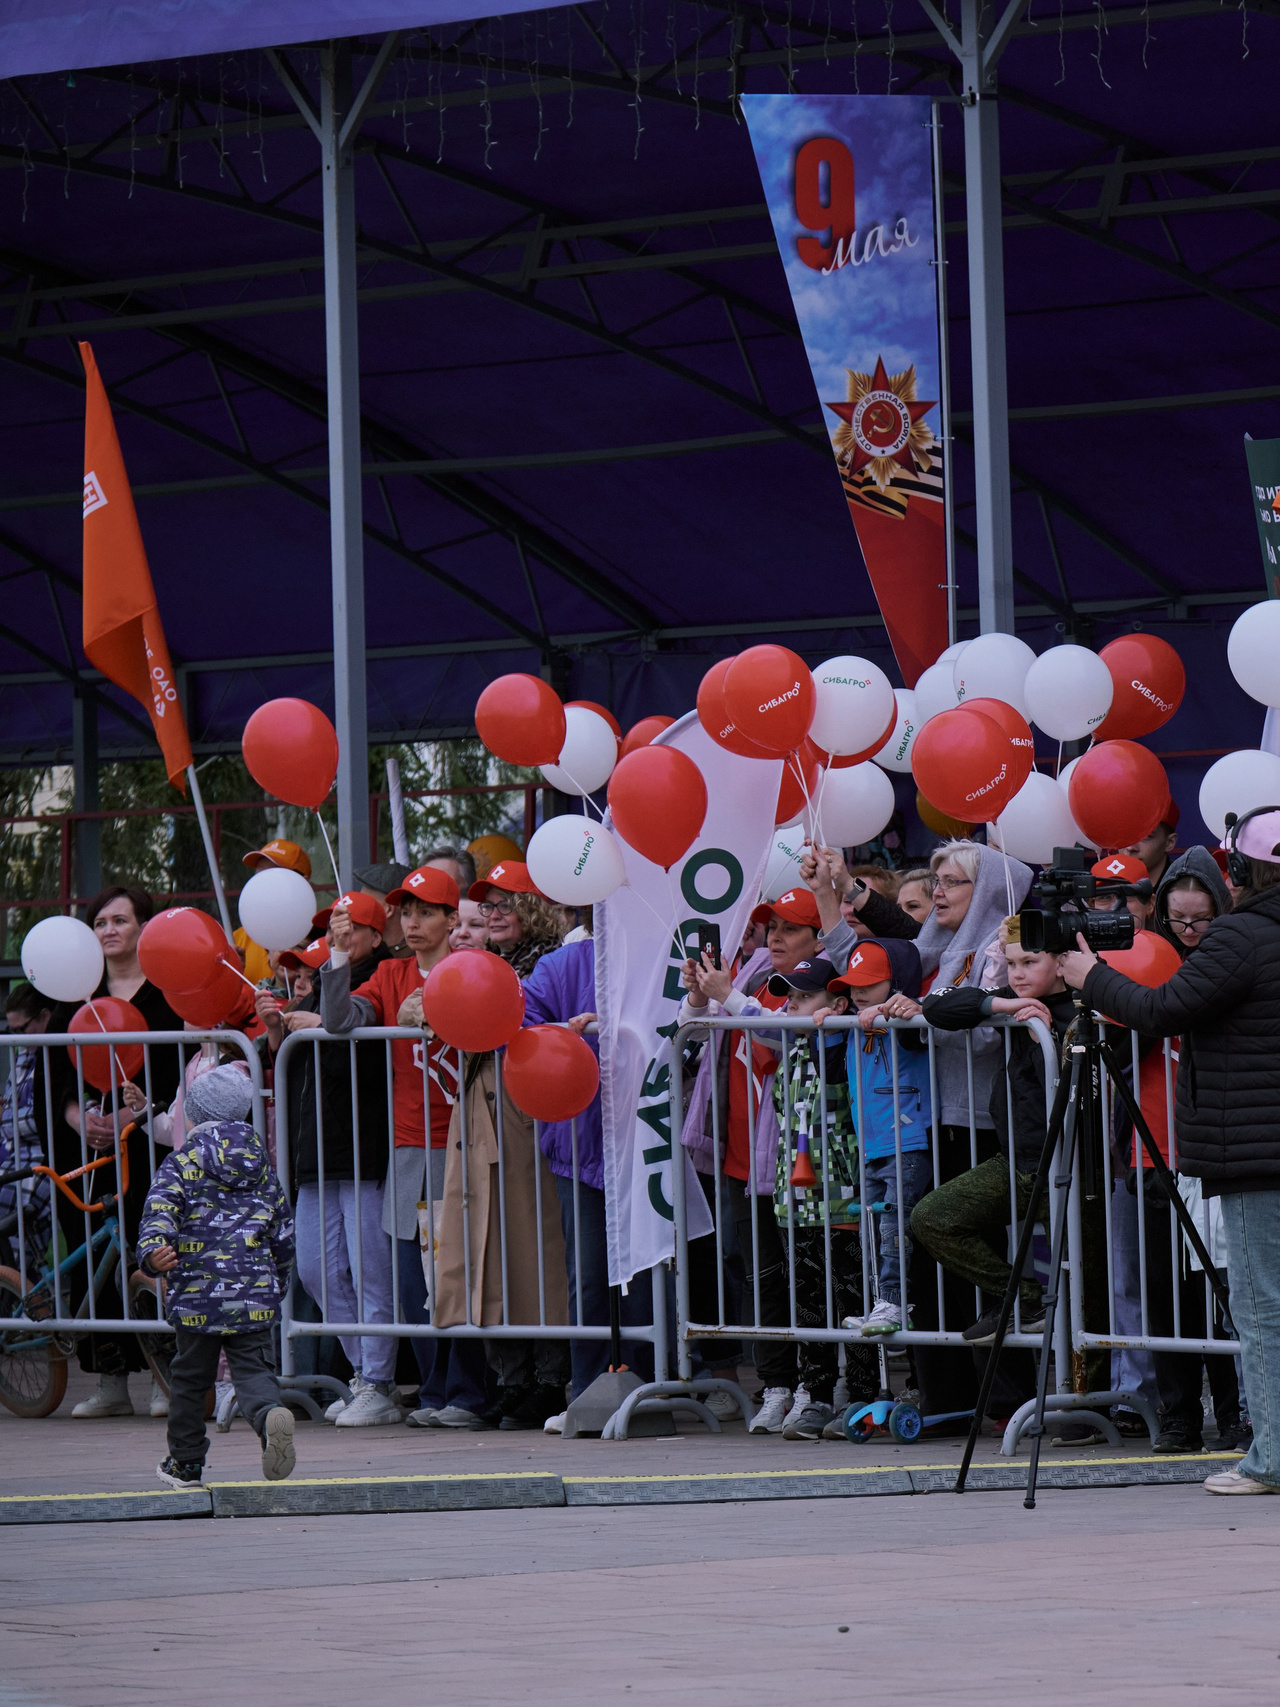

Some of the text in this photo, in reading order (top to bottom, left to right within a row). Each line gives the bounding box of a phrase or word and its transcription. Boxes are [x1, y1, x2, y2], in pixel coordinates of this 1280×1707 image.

[796, 138, 855, 271] 9
[821, 217, 920, 276] мая
[855, 393, 905, 451] ОТЕЧЕСТВЕННАЯ
[758, 687, 800, 714] СИБАГРО
[822, 676, 866, 689] СИБАГРО
[1131, 680, 1168, 712] СИБАГРО
[895, 725, 914, 761] СИБАГРО
[965, 770, 1006, 802] СИБАГРО
[573, 836, 595, 876] СИБАГРО
